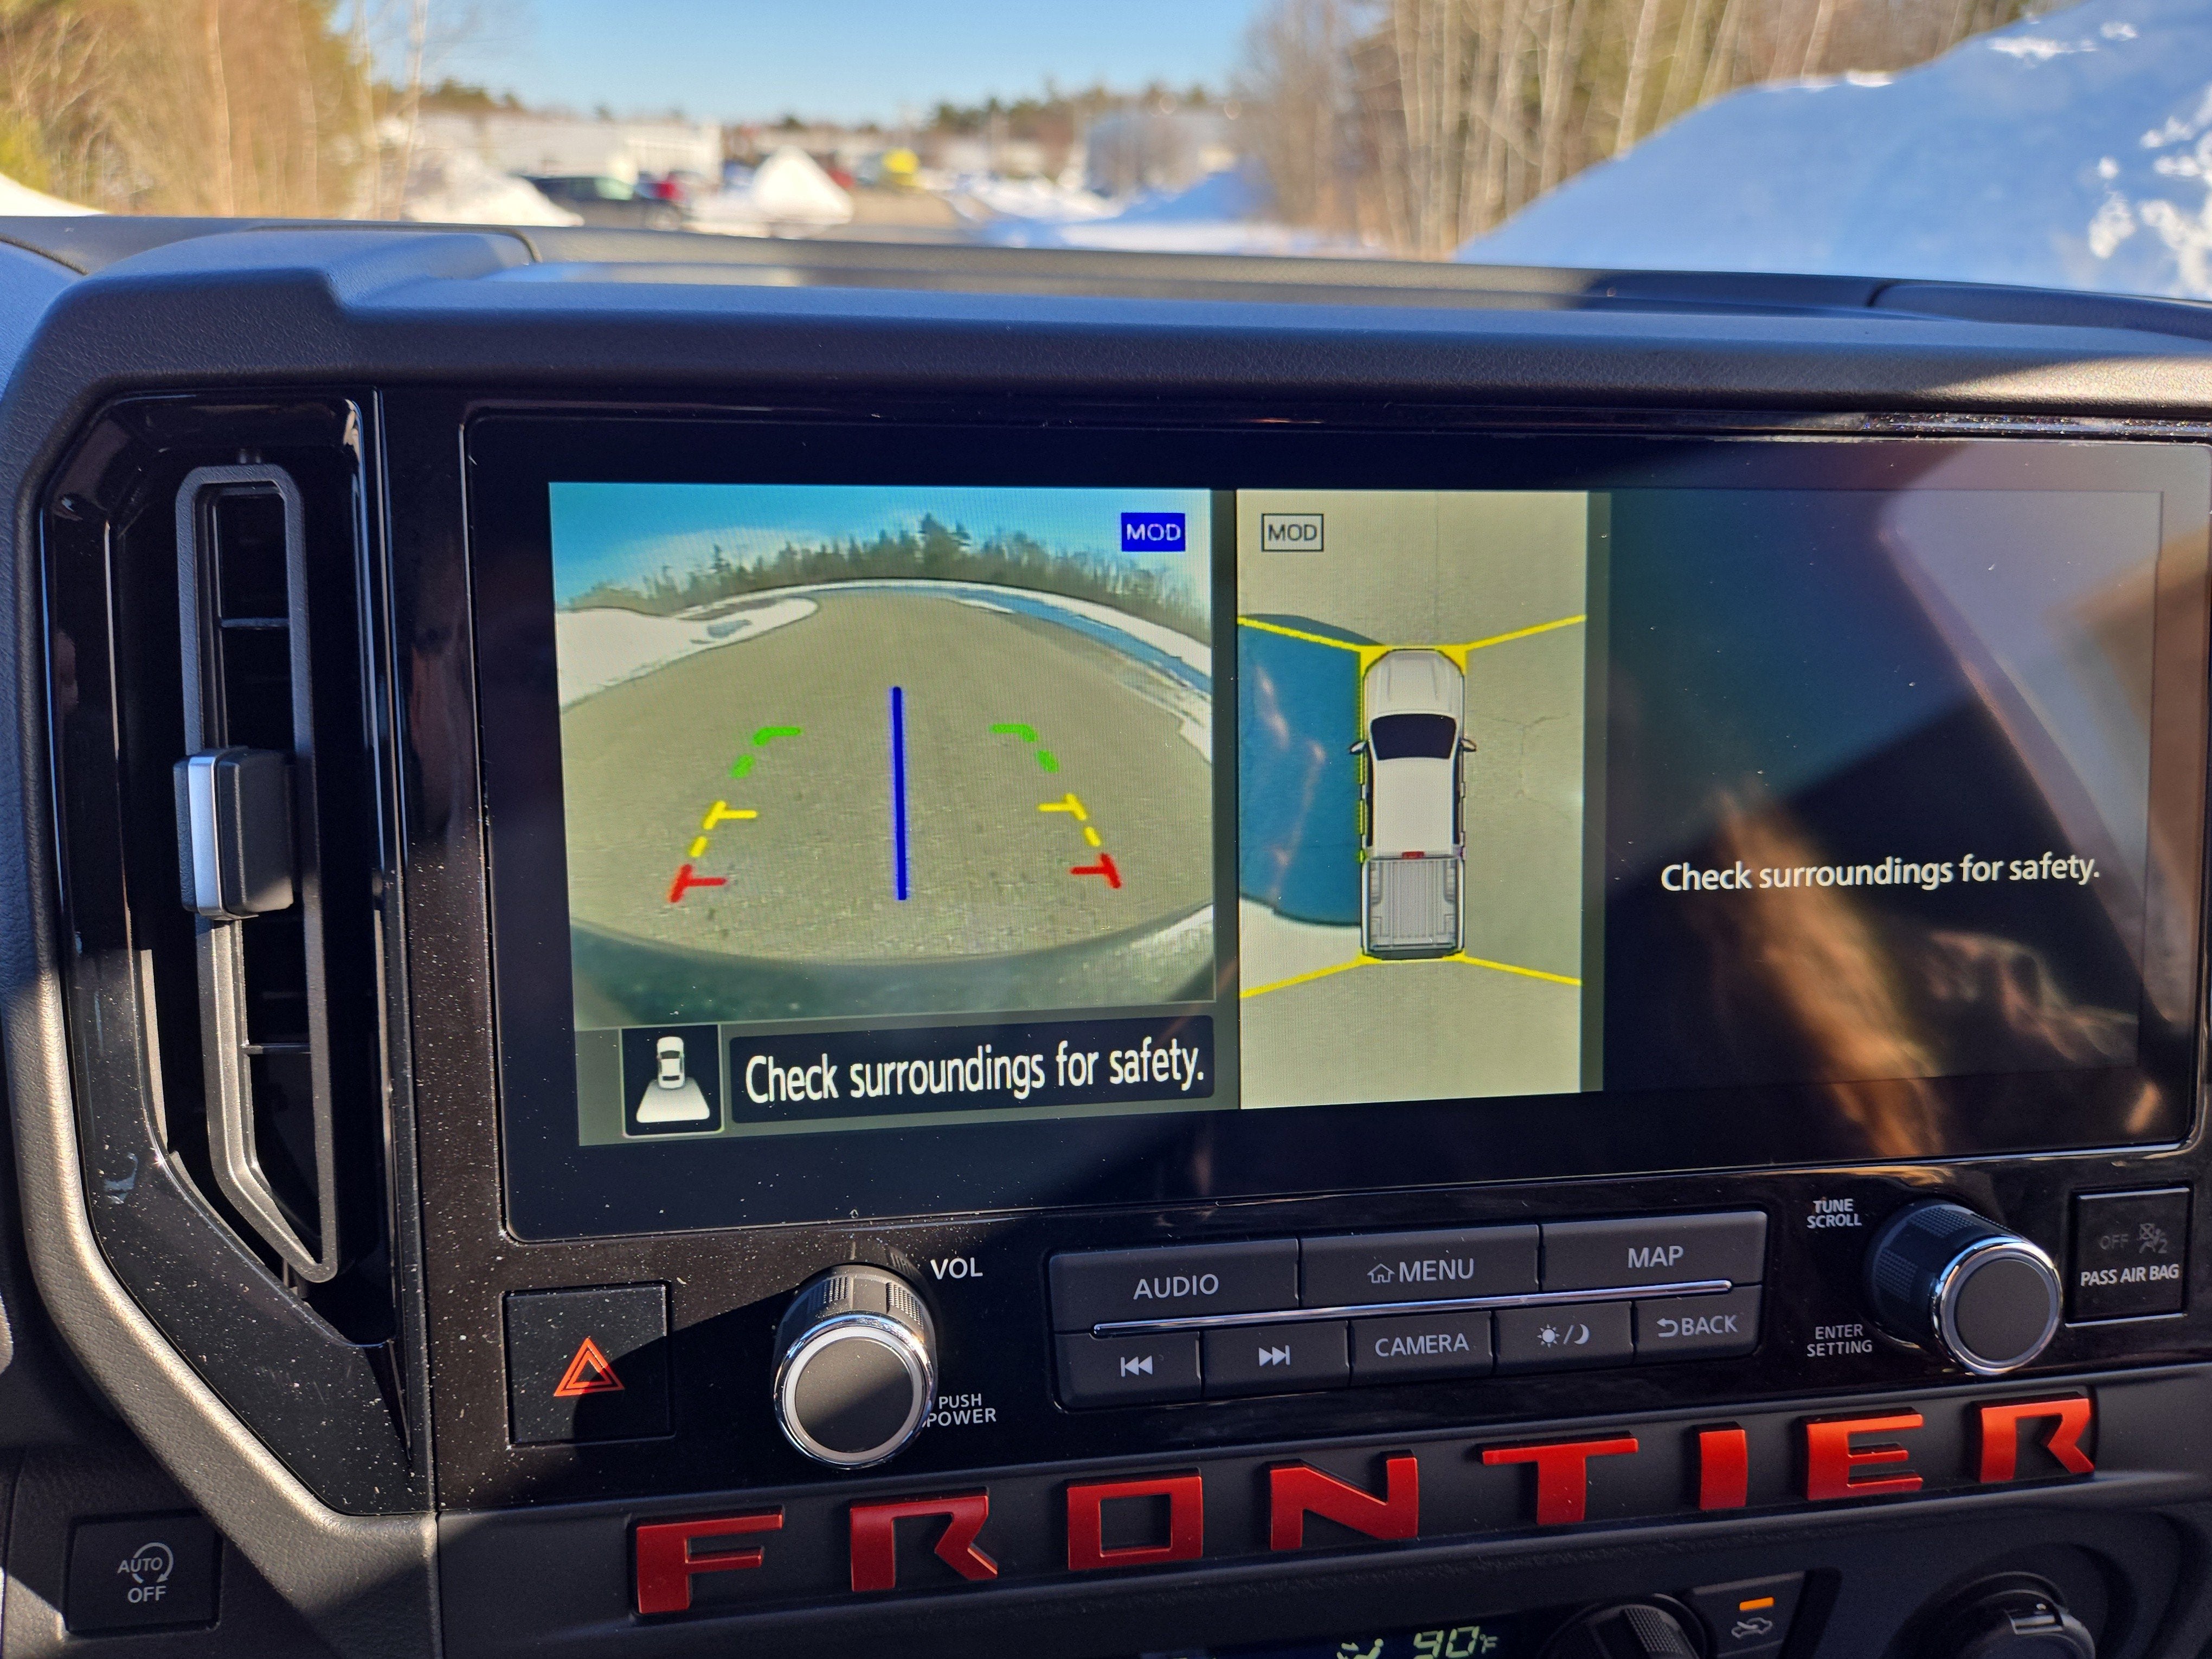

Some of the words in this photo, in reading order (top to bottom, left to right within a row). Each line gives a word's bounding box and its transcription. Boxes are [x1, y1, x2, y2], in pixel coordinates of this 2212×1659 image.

[1126, 523, 1181, 541] MOD
[1268, 524, 1317, 542] MOD
[1661, 861, 1752, 891] Check
[1758, 856, 1953, 890] surroundings
[1959, 854, 2004, 882] for
[2009, 851, 2100, 886] safety.
[745, 1053, 839, 1104] Check
[849, 1044, 1045, 1099] surroundings
[1056, 1040, 1099, 1085] for
[1109, 1037, 1205, 1090] safety.
[1814, 1198, 1854, 1213] TUNE
[1806, 1212, 1862, 1229] SCROLL
[1628, 1245, 1685, 1268] MAP
[930, 1258, 983, 1279] VOL
[1398, 1258, 1475, 1283] MENU
[2080, 1269, 2118, 1287] PASS
[2120, 1266, 2146, 1283] AIR
[2149, 1263, 2180, 1280] BAG
[1134, 1274, 1219, 1301] AUDIO
[1682, 1314, 1738, 1336] BACK
[1815, 1323, 1863, 1340] ENTER
[1375, 1333, 1470, 1358] CAMERA
[1806, 1340, 1873, 1357] SETTING
[938, 1393, 982, 1410] PUSH
[926, 1408, 997, 1428] POWER
[635, 1396, 2096, 1616] FRONTIER
[117, 1557, 163, 1573] AUTO
[127, 1585, 166, 1603] OFF
